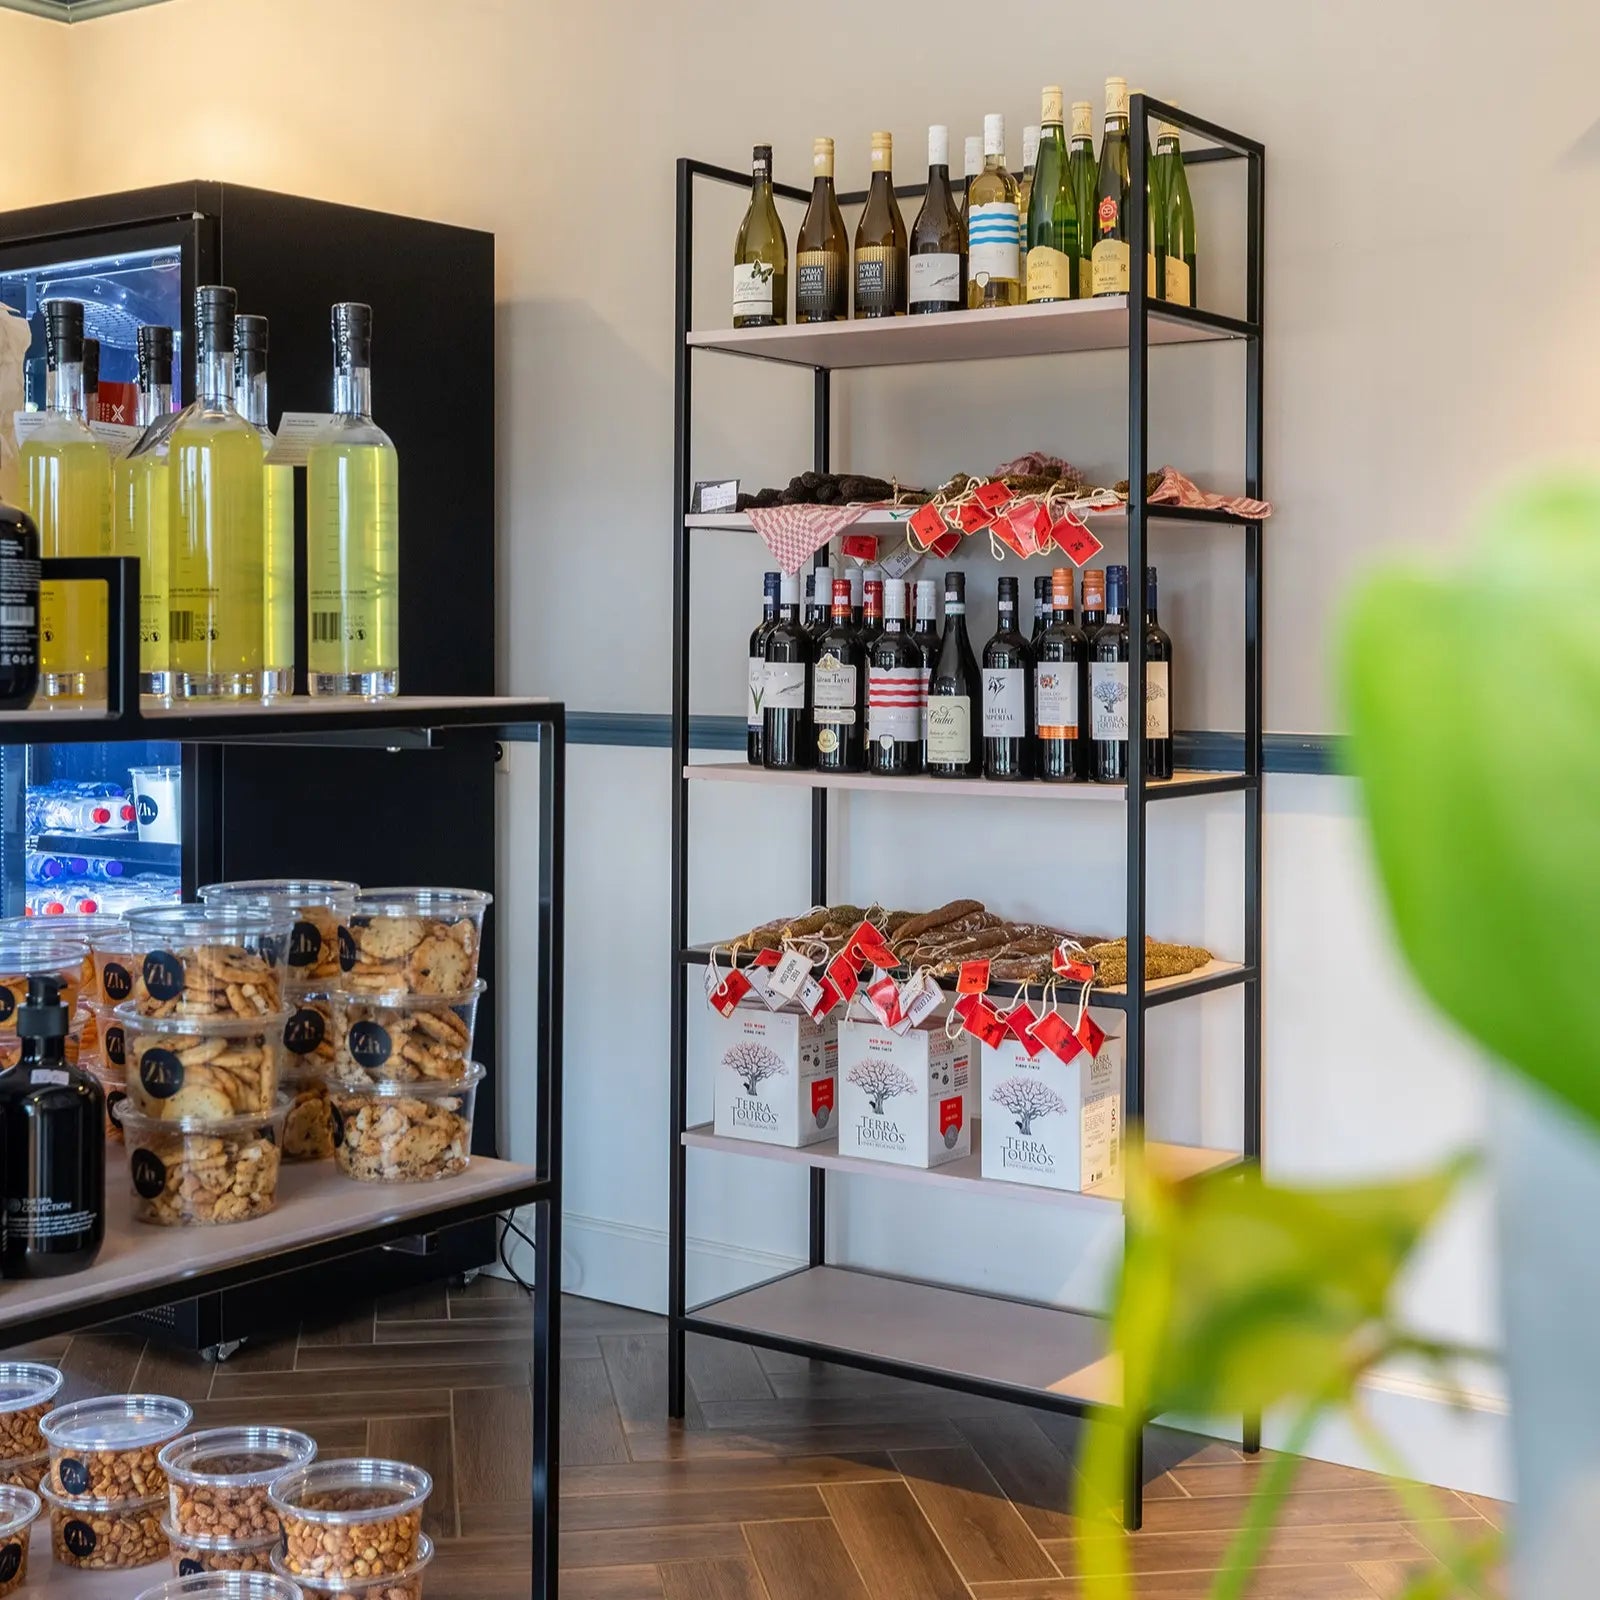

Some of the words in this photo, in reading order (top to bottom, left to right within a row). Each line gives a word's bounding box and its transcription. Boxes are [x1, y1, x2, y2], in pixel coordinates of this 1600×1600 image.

[1099, 715, 1125, 723] TERRA
[735, 1097, 771, 1114] TERRA
[731, 1106, 778, 1126] TOUROS
[861, 1115, 899, 1133] TERRA
[856, 1125, 905, 1145] TOUROS
[1006, 1136, 1047, 1154] TERRA
[1000, 1146, 1055, 1168] TOUROS
[21, 1201, 72, 1213] COLLECTION
